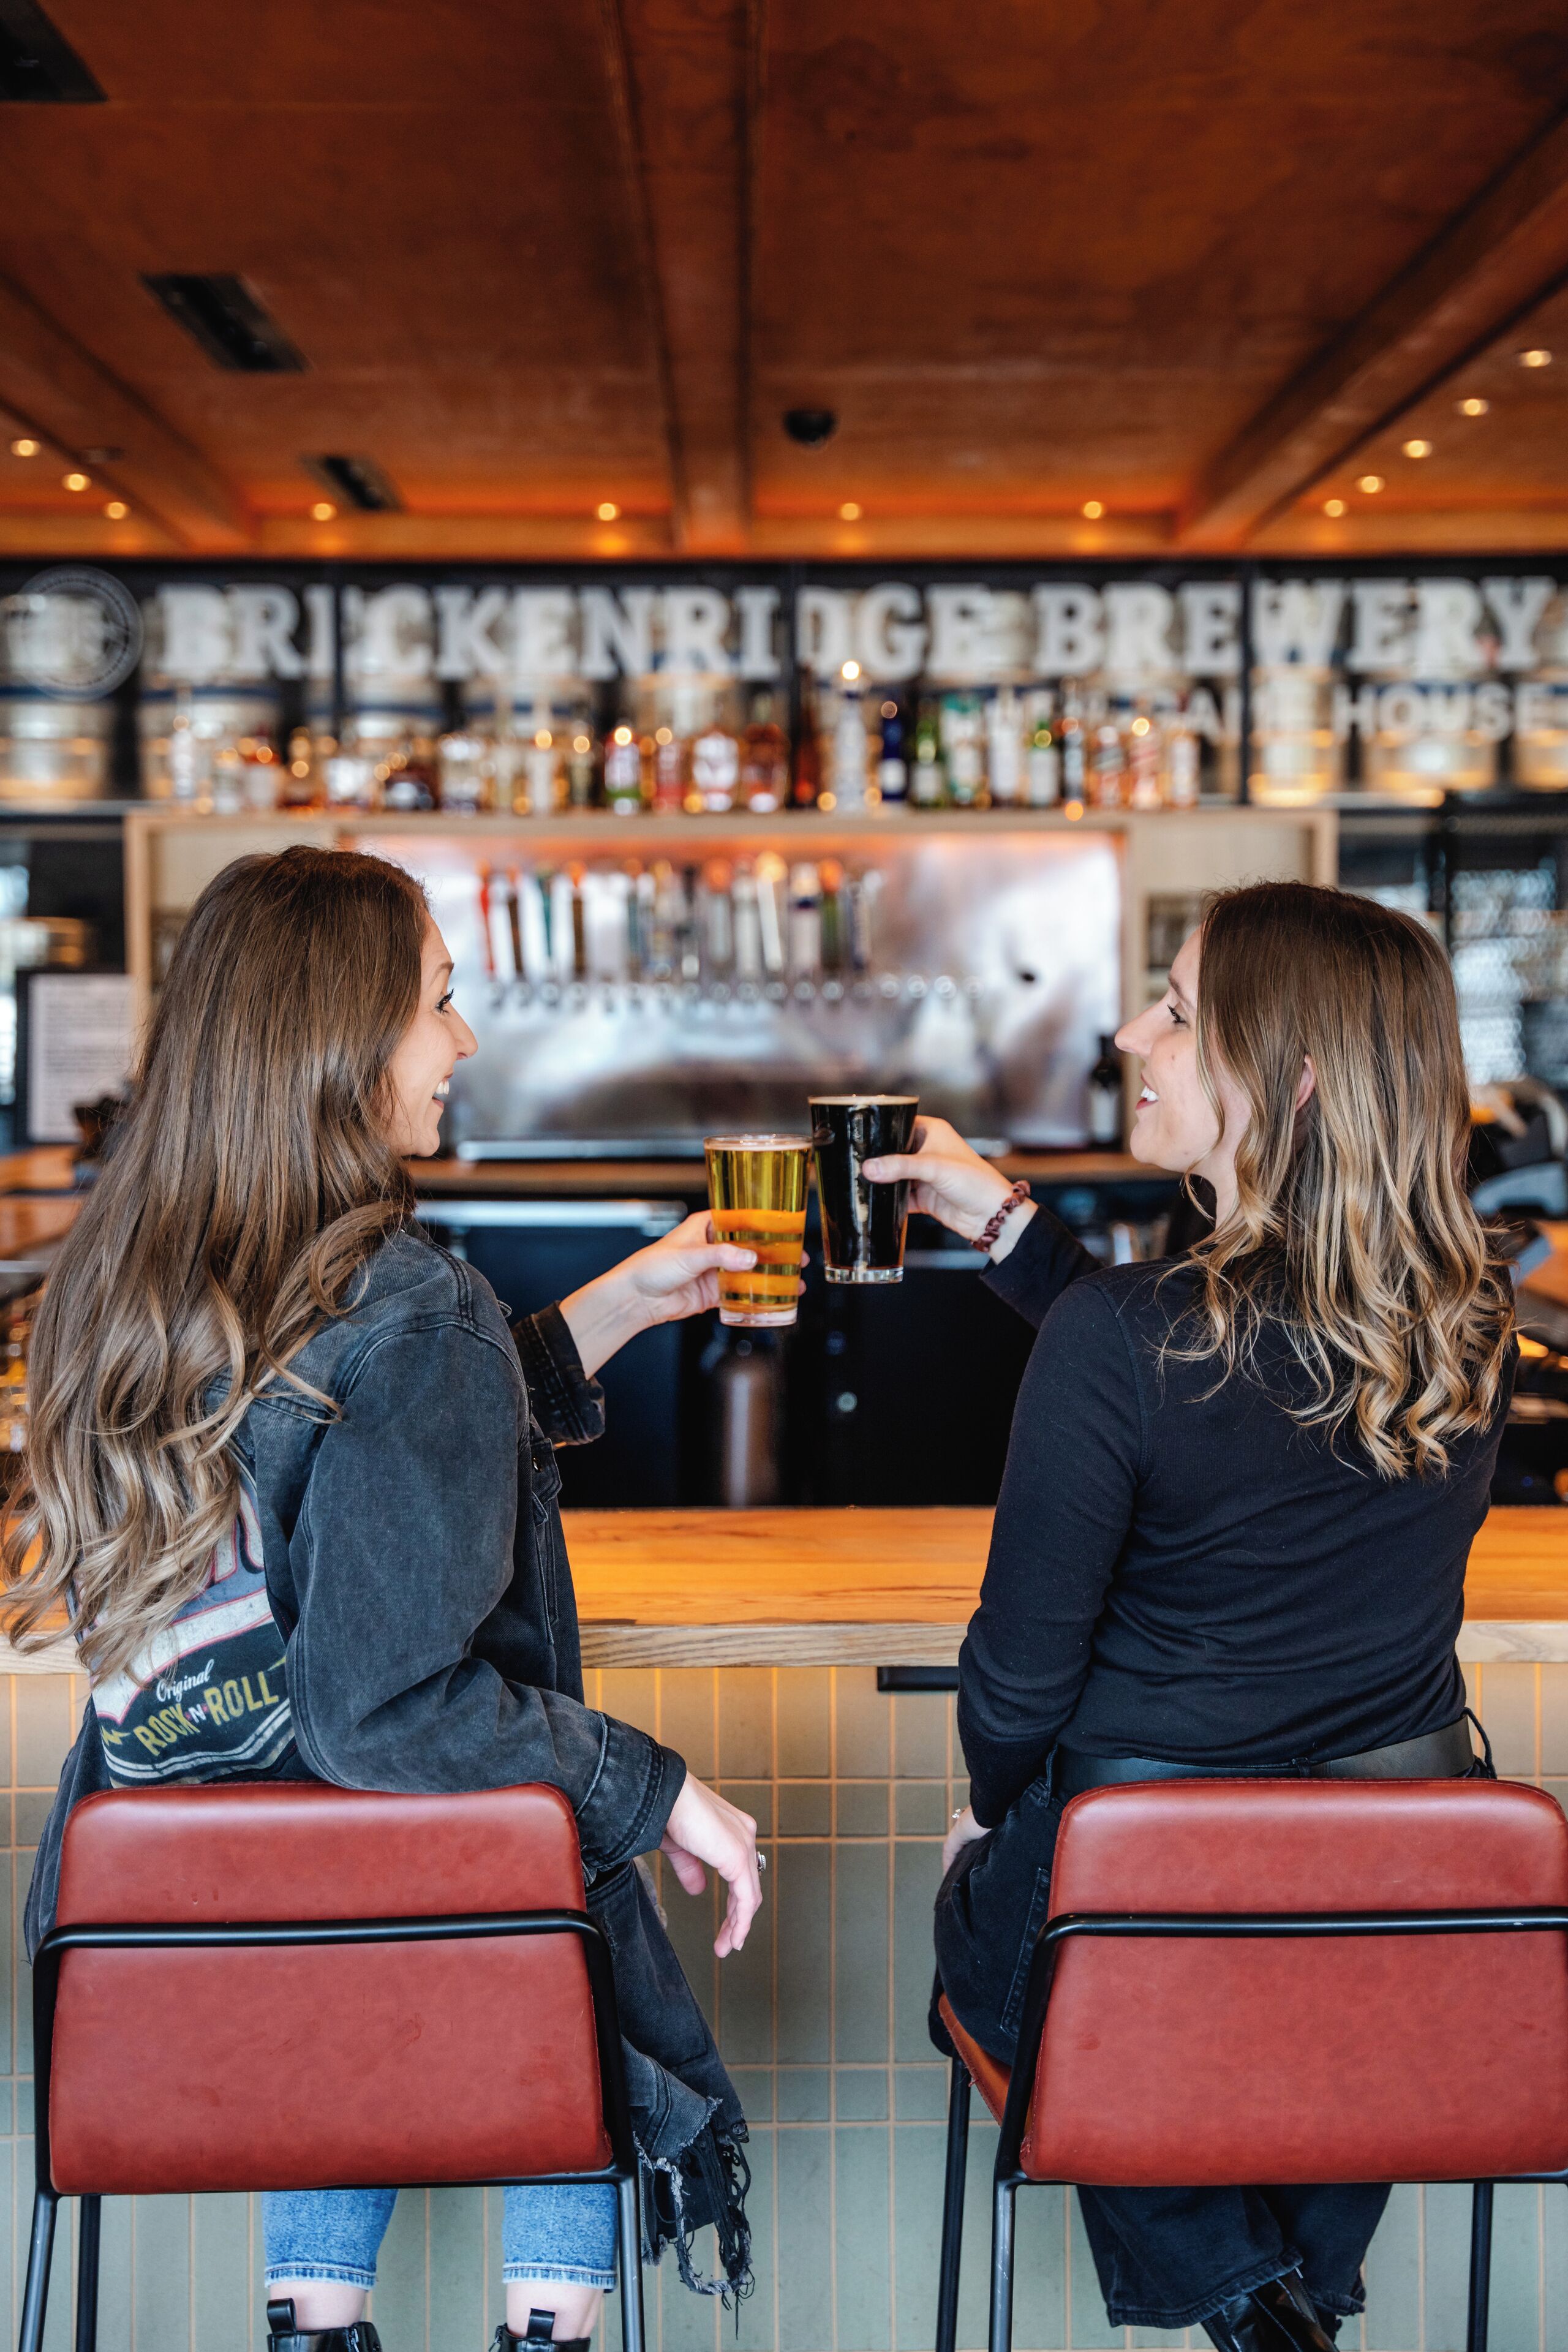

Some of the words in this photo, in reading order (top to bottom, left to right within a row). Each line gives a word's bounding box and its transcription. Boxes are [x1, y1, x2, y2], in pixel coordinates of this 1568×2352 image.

[1032, 575, 1558, 676] BREWERY
[1333, 681, 1552, 742] HOUSE
[133, 1703, 200, 1756] ROCK
[203, 1671, 279, 1726] ROLL
[156, 1658, 214, 1703] Original
